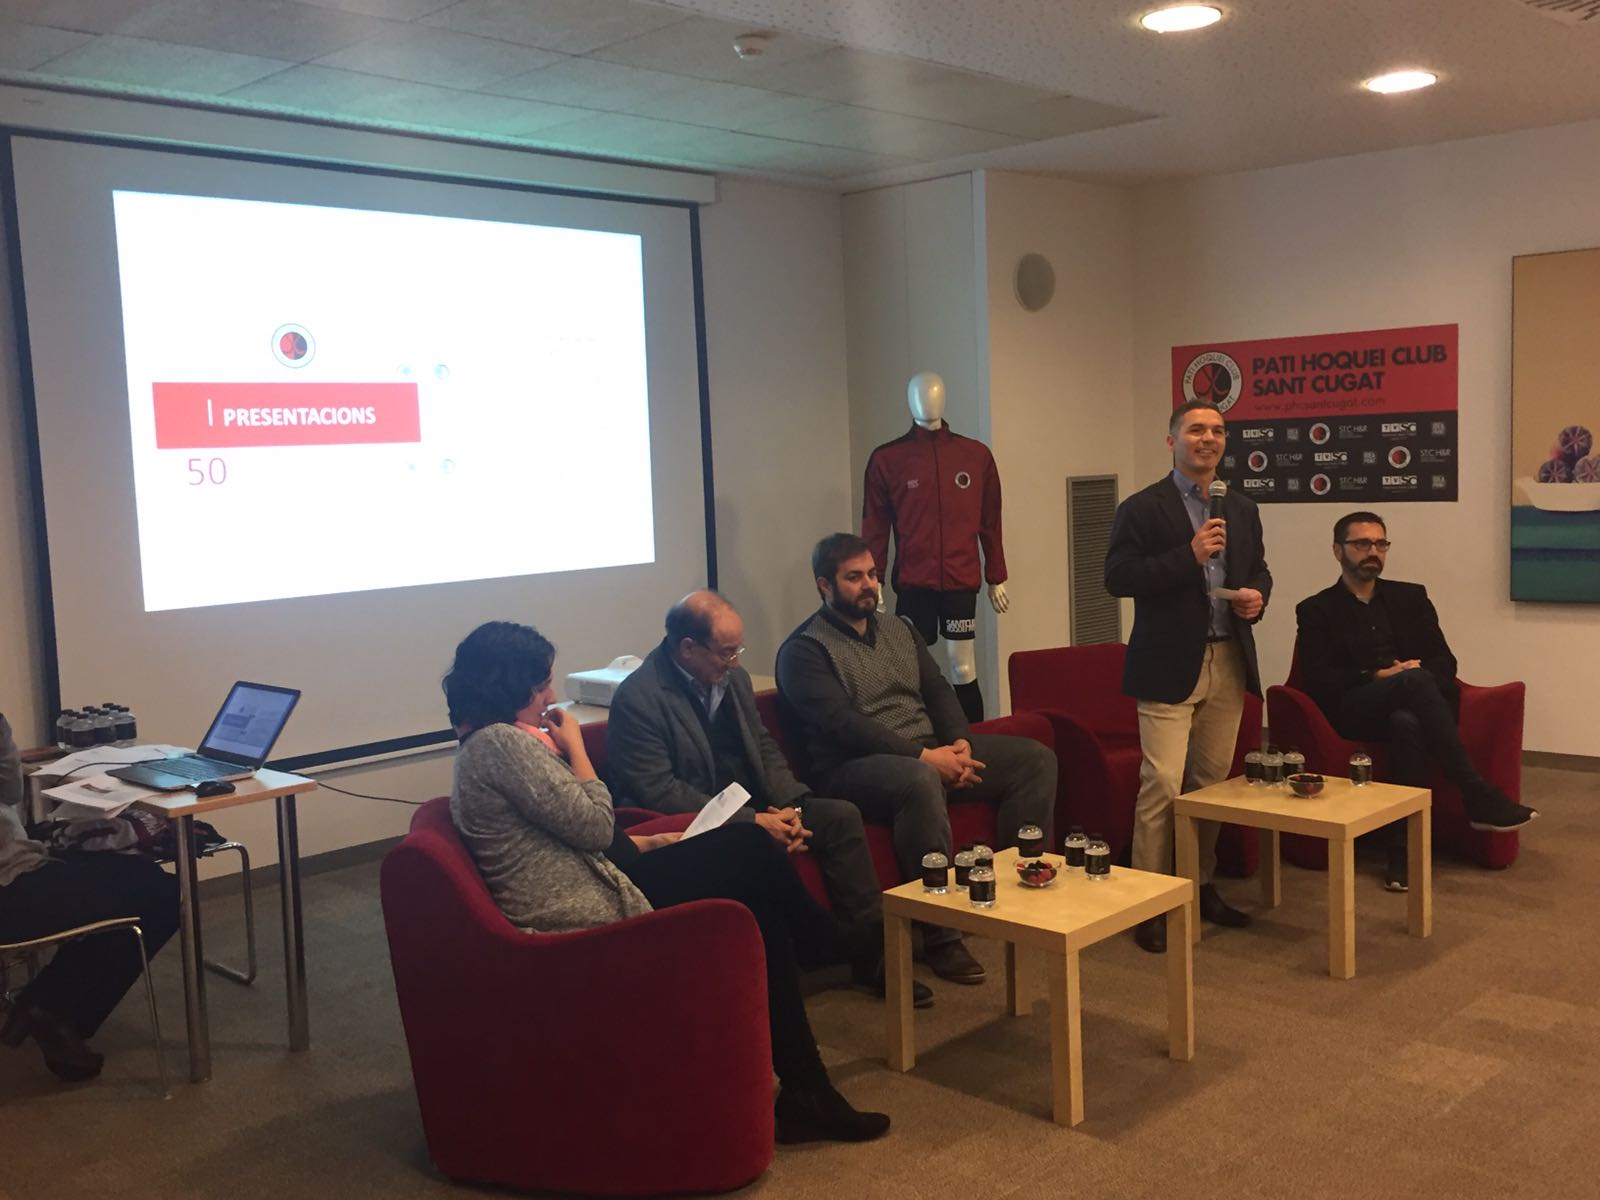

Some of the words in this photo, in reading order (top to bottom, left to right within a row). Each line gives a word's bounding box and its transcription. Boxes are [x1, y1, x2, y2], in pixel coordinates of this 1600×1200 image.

[1252, 356, 1294, 374] PATI
[1301, 348, 1386, 373] HOQUEI
[1392, 345, 1447, 366] CLUB
[1253, 376, 1306, 397] SANT
[1311, 372, 1385, 393] CUGAT
[223, 406, 377, 428] PRESENTACIONS
[1255, 397, 1386, 412] www.phcsantcugat.com
[187, 457, 227, 487] 50
